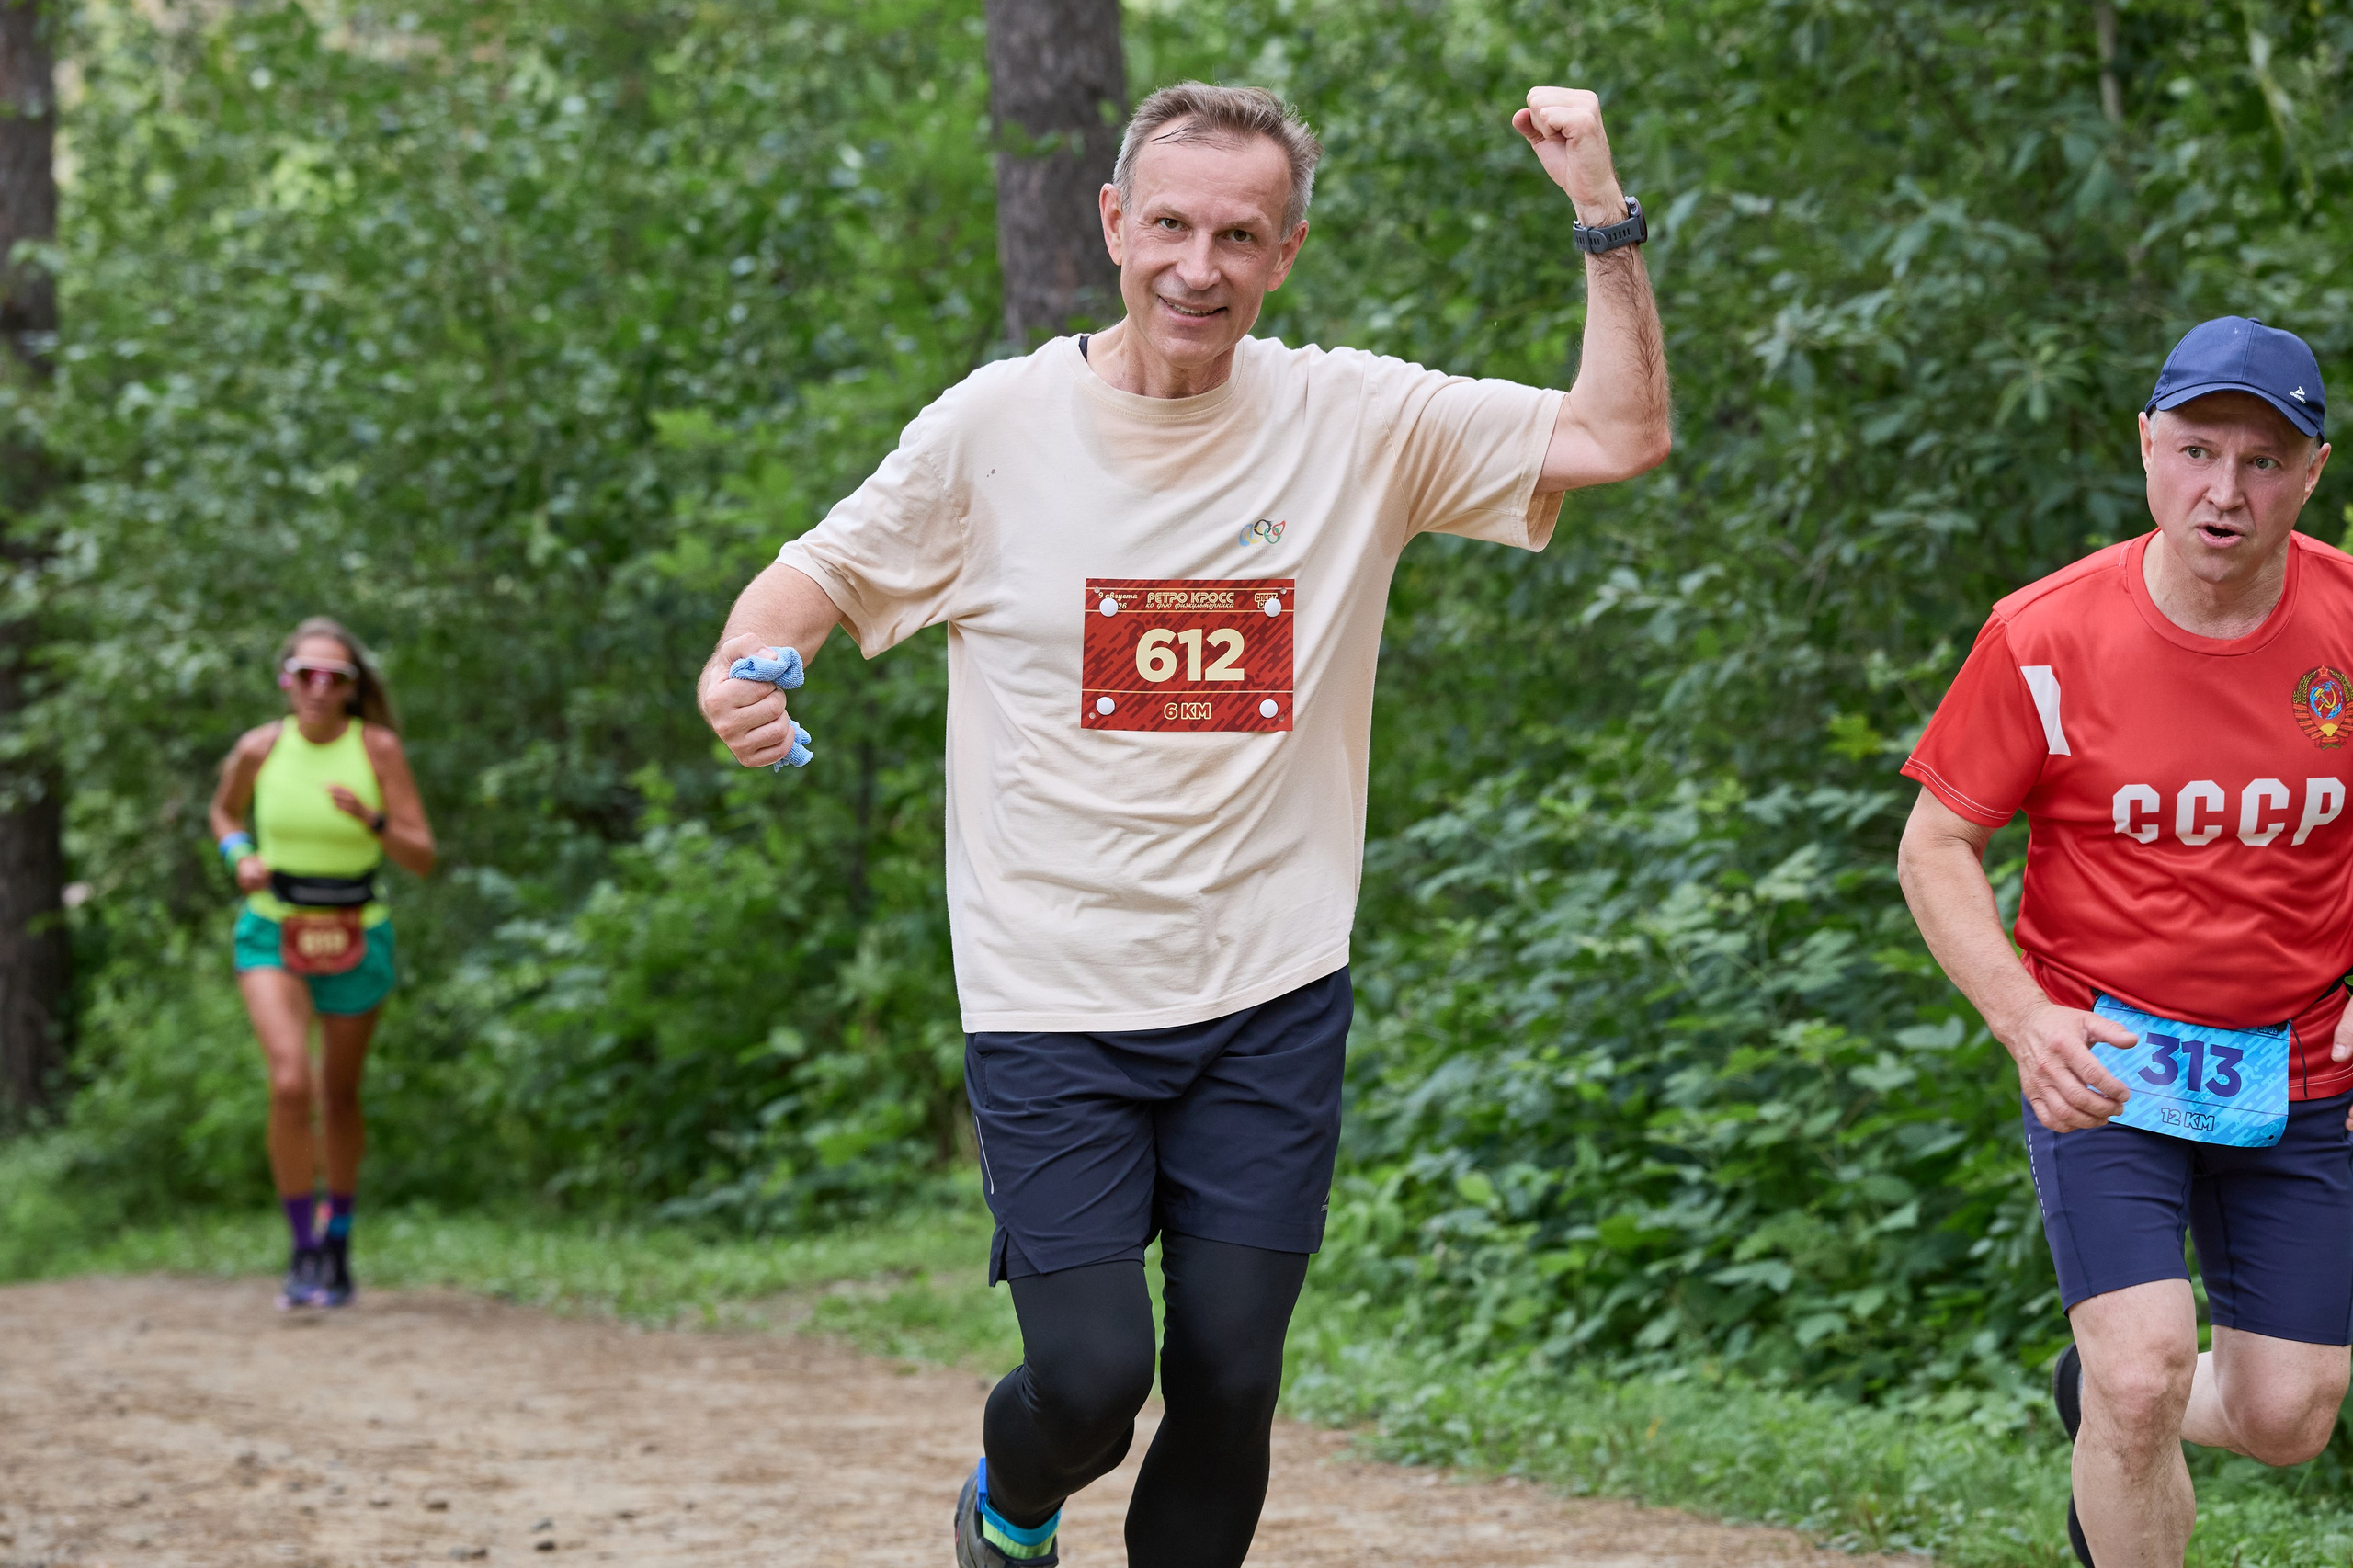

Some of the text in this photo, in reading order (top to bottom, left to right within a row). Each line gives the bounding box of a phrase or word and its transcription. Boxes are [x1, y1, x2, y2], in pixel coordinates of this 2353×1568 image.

[1098, 591, 1138, 602] 9 августа
[1147, 592, 1235, 604] РЕТРО КРОСС
[1255, 593, 1278, 601] СПОРТ
[1135, 628, 1245, 683] 612
[1163, 702, 1178, 720] 6
[2112, 777, 2346, 847] СССР
[2137, 1031, 2245, 1098] 313
[2160, 1107, 2182, 1127] 12
